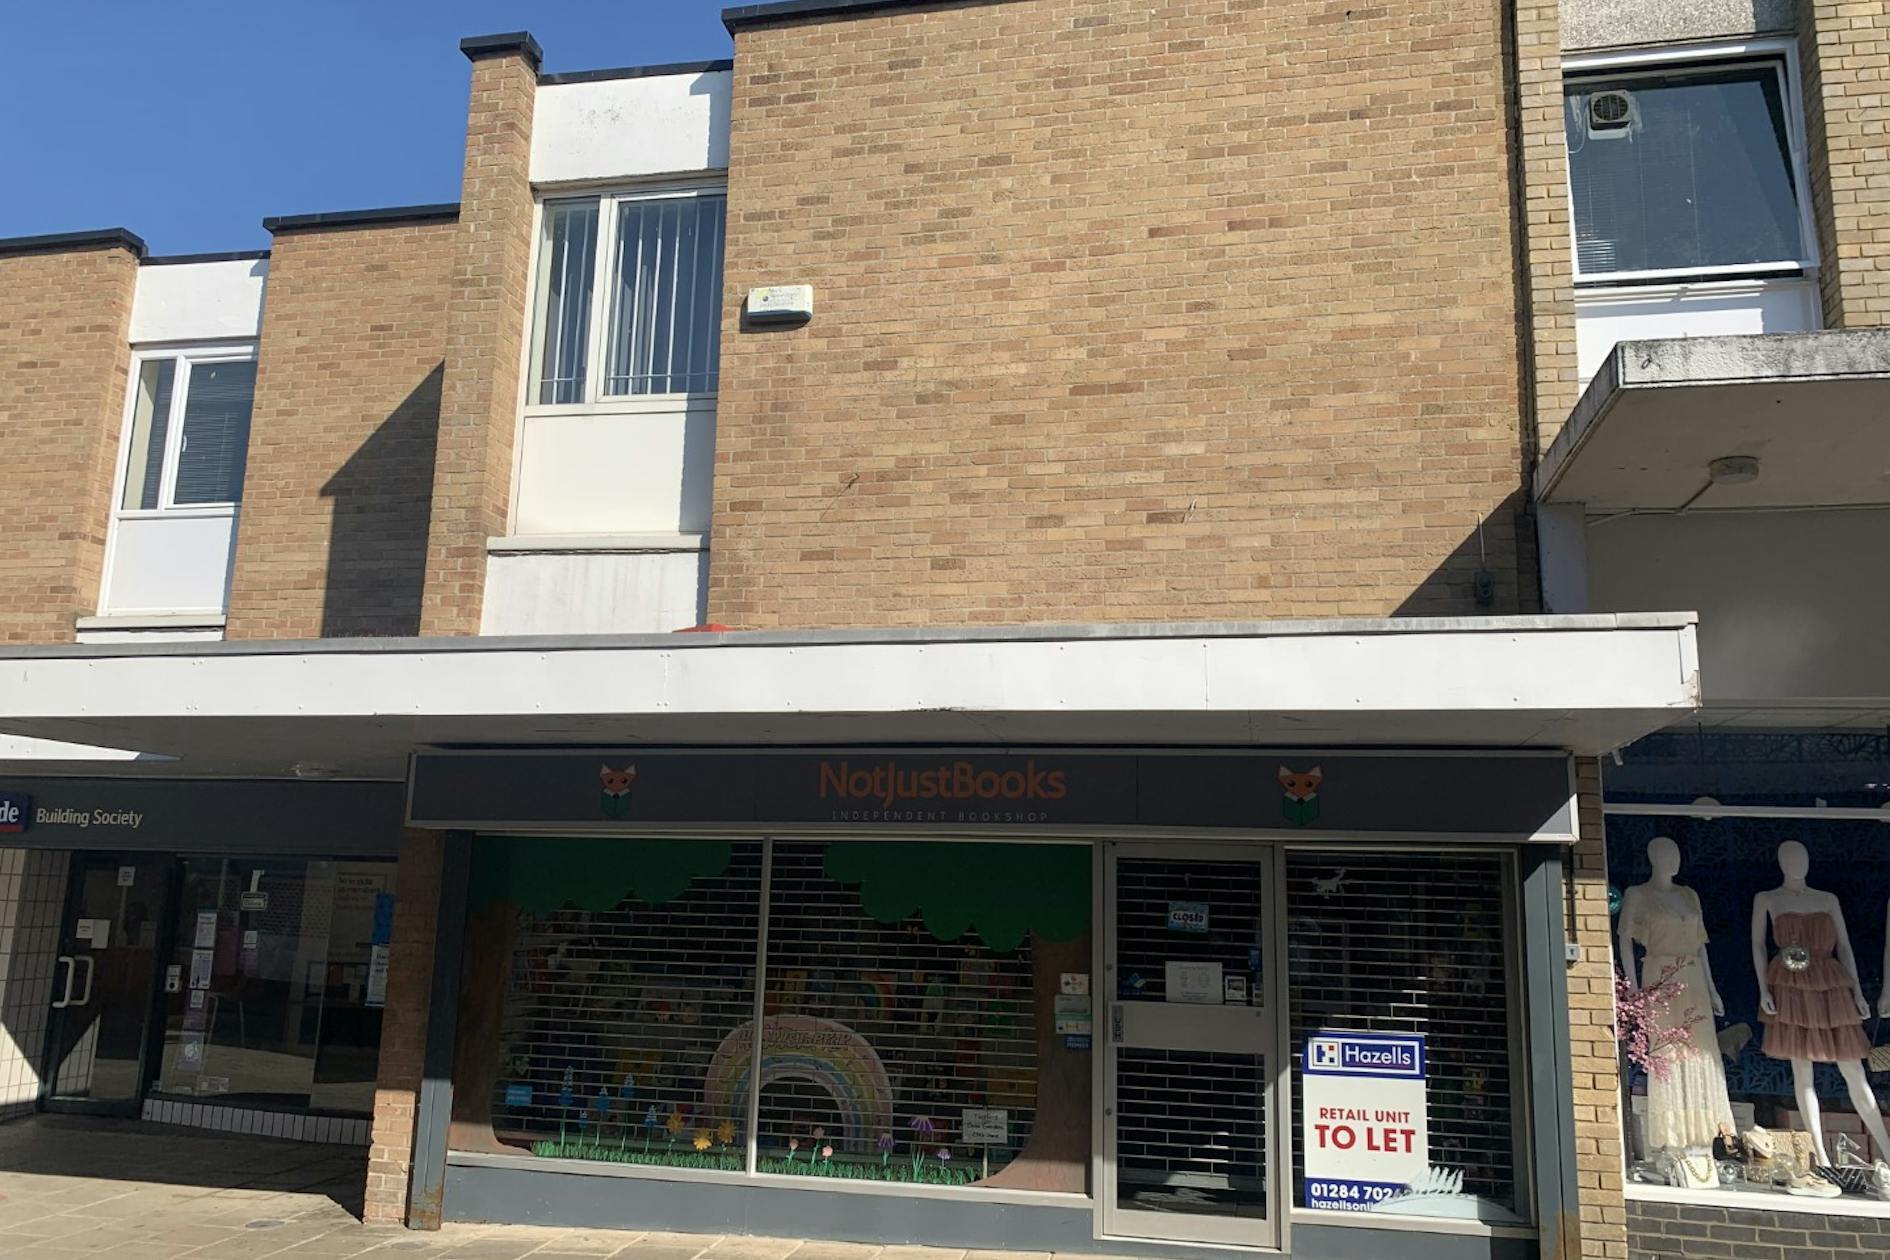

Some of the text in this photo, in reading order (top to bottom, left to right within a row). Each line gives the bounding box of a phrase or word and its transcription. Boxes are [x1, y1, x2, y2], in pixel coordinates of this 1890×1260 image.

[819, 760, 1067, 808] NotJustBooks
[36, 808, 143, 828] Building Society
[832, 810, 1049, 822] INDEPENDENT BOOKSHOP
[1345, 1046, 1411, 1065] Hazells
[1319, 1107, 1410, 1124] RETAIL UNIT
[1315, 1125, 1416, 1154] TO LET
[1311, 1182, 1360, 1200] 01284
